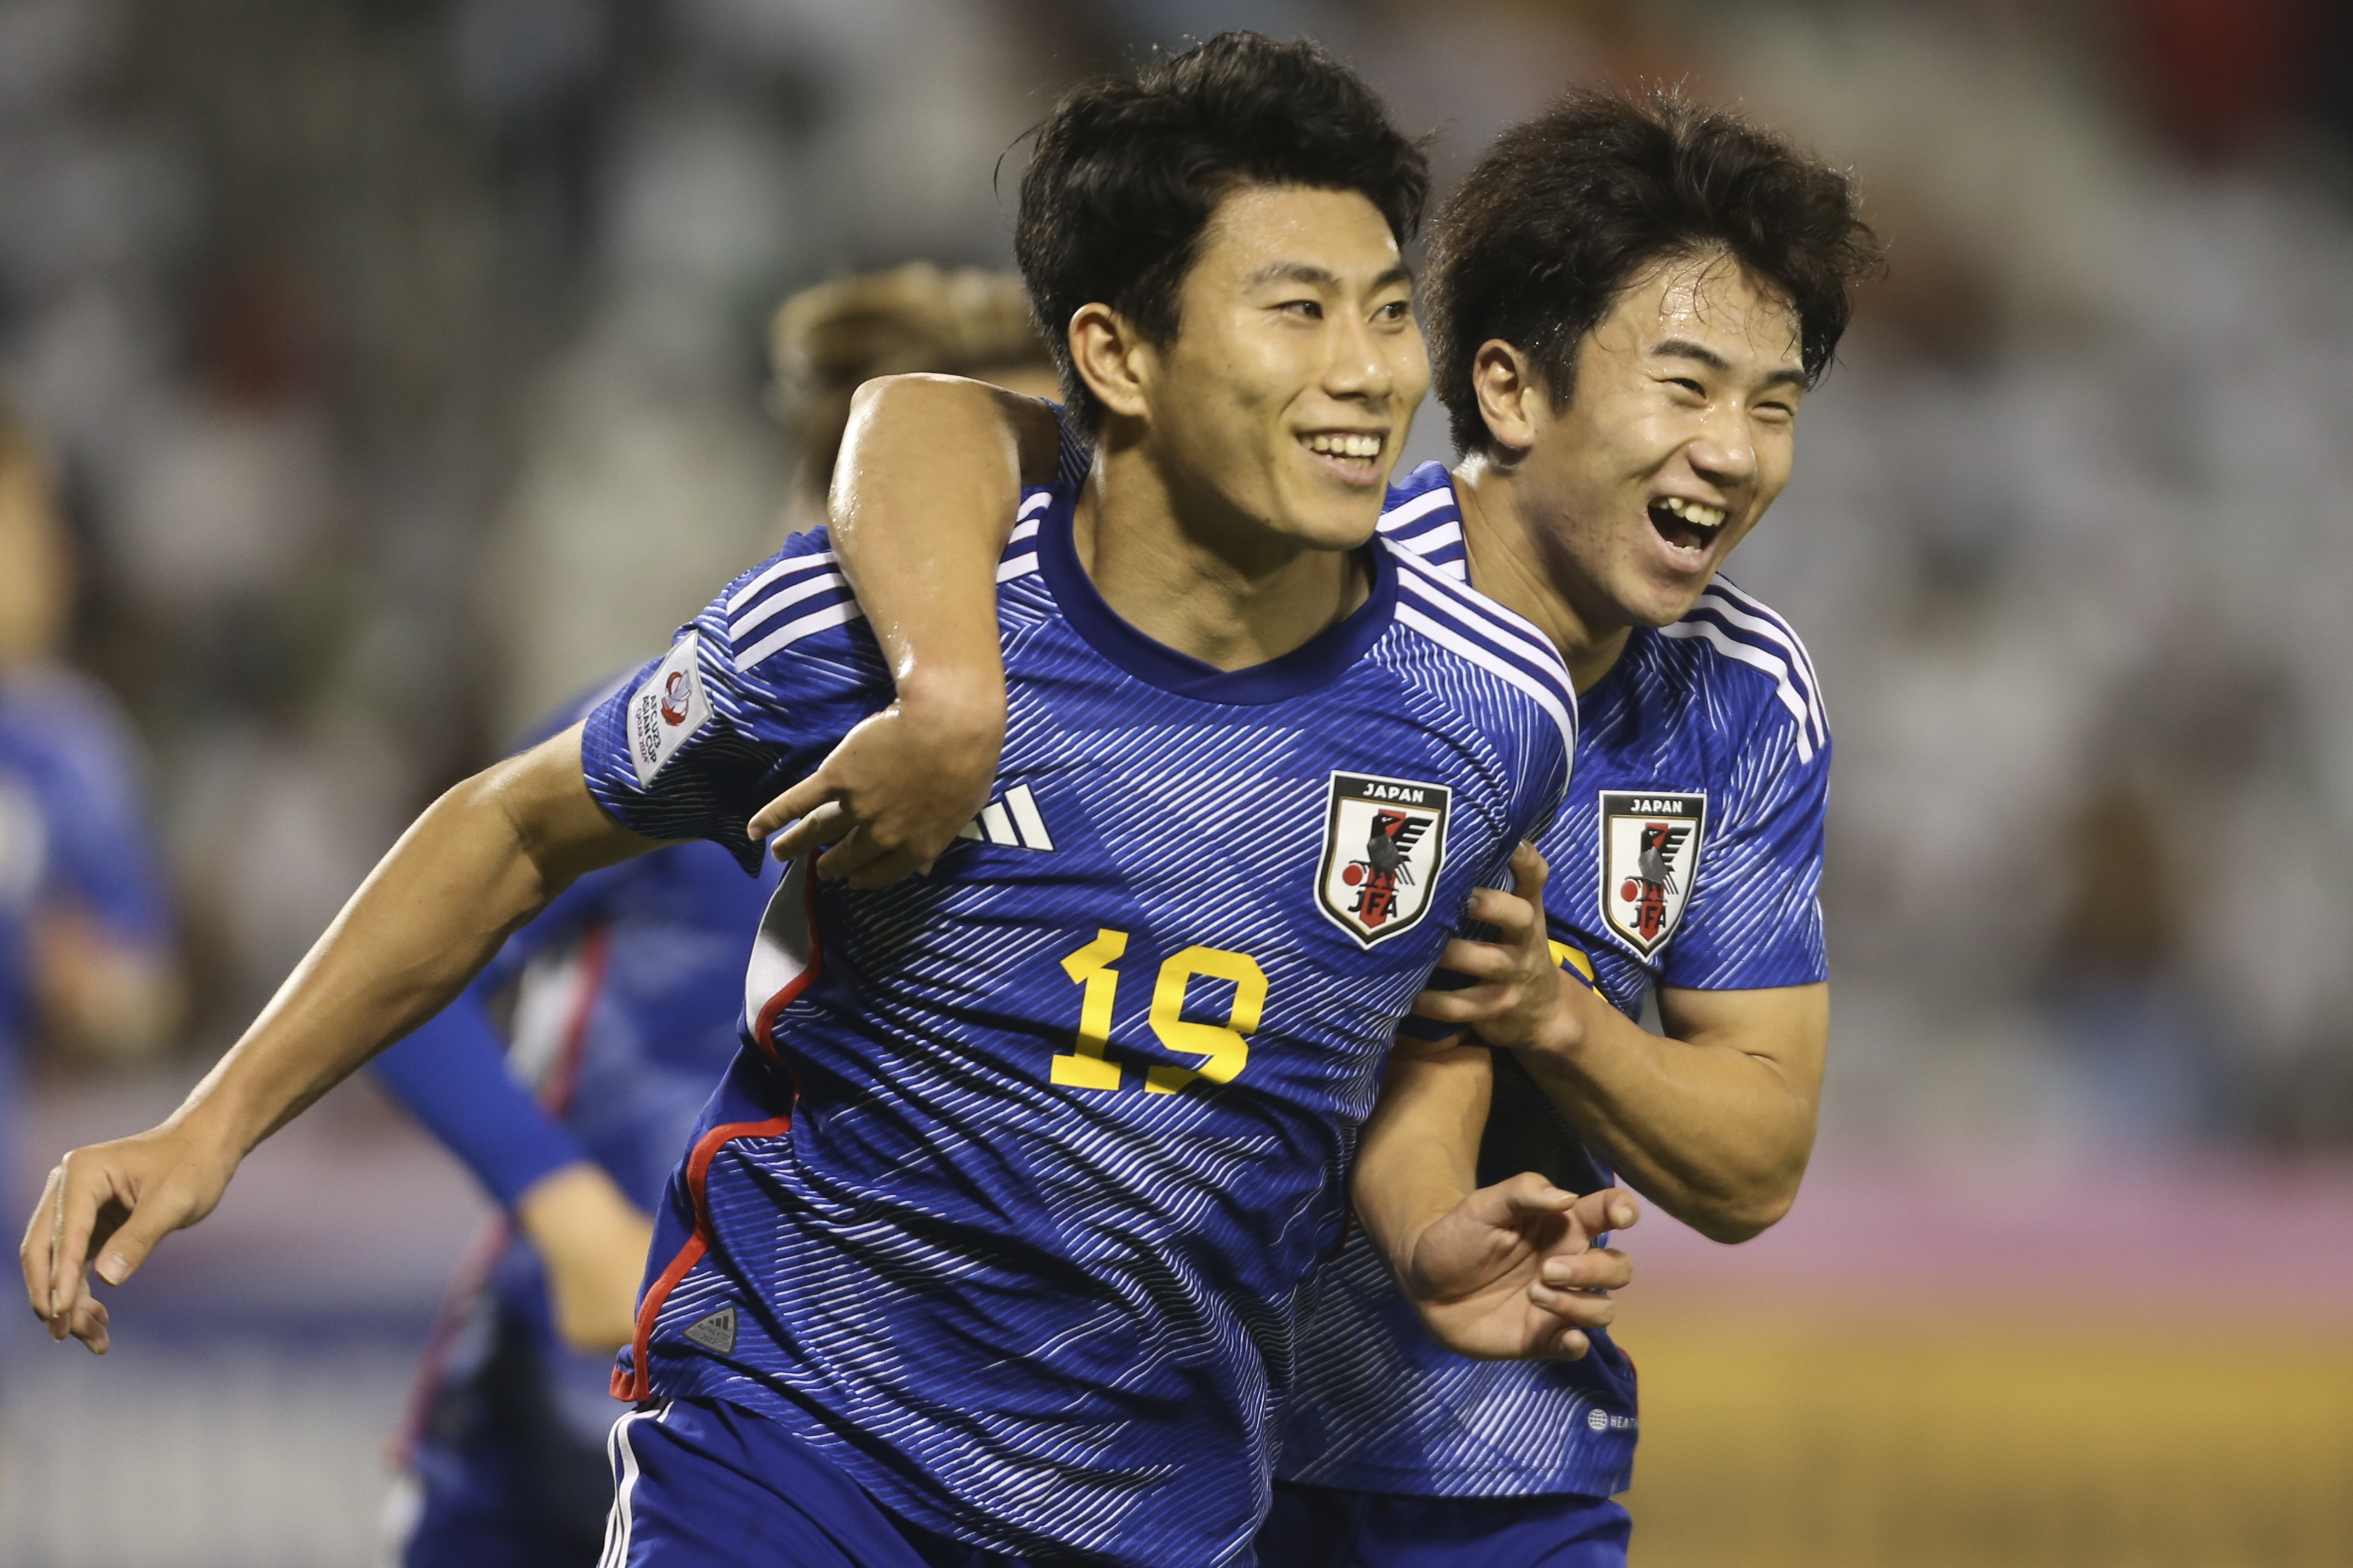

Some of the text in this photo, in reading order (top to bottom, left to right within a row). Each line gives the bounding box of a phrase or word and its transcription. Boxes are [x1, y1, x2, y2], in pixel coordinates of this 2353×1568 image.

[642, 695, 657, 763] ASIAN CUP
[652, 721, 661, 749] U23
[1362, 783, 1425, 802] JAPAN
[1630, 799, 1682, 813] JAPAN
[1347, 890, 1397, 918] JFA
[1629, 905, 1666, 929] JFA
[1049, 928, 1269, 1095] 19
